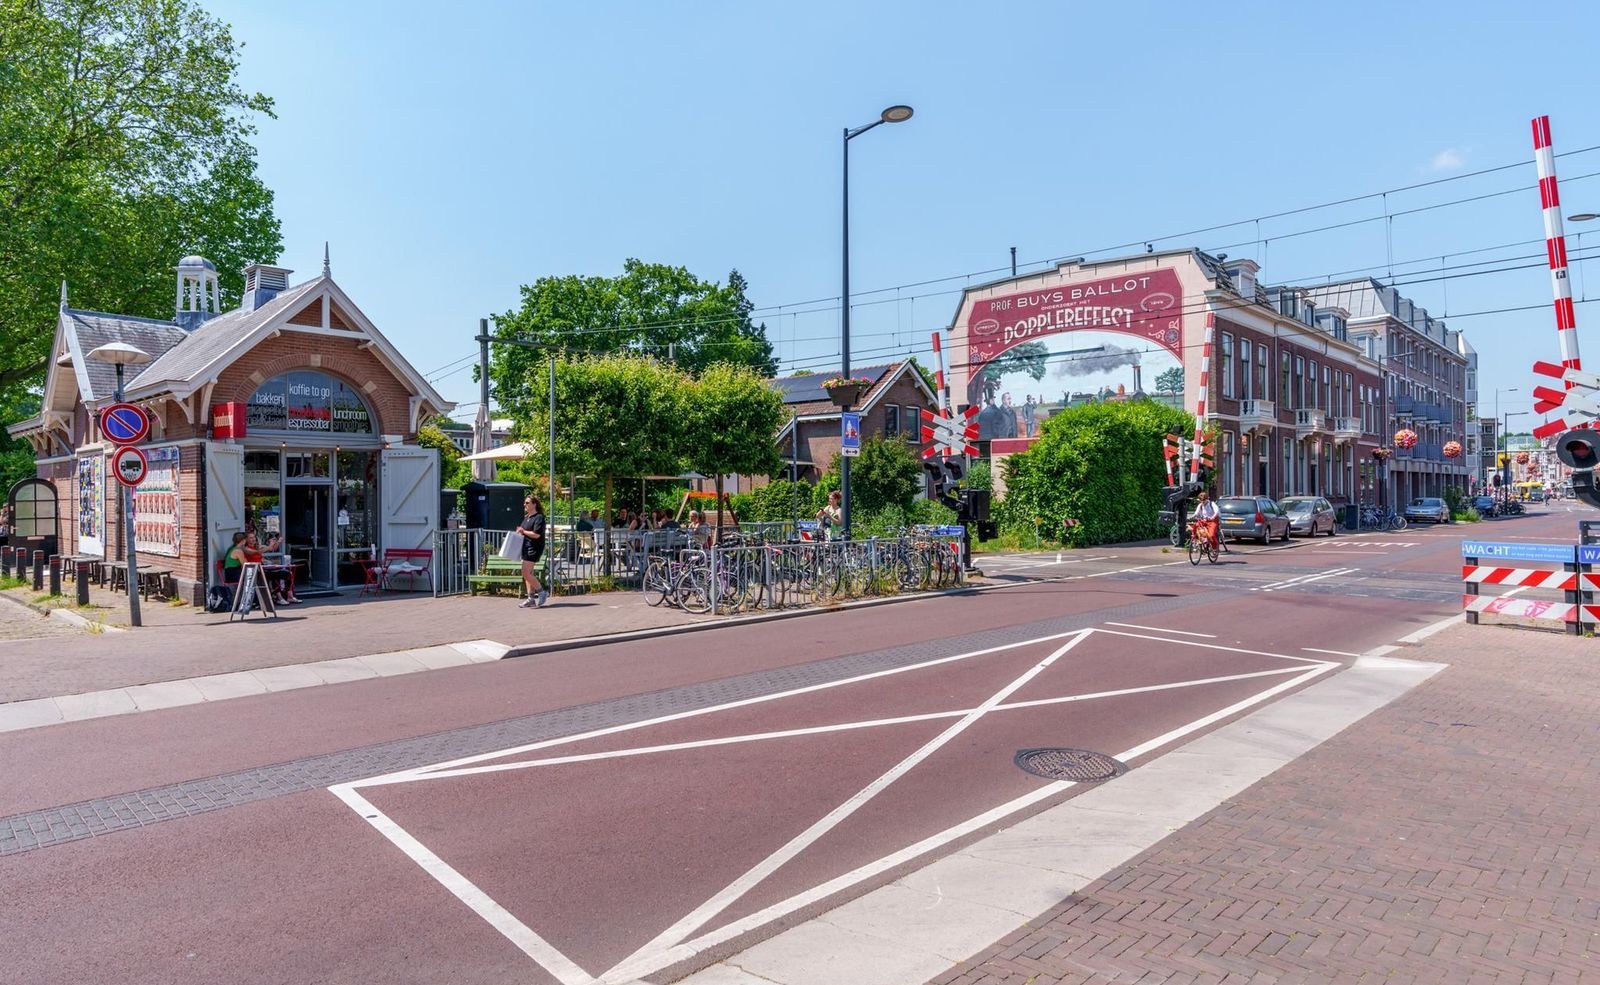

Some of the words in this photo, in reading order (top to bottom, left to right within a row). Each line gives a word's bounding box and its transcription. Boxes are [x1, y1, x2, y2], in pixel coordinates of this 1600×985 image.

[991, 300, 1013, 312] PROF.
[1017, 291, 1063, 308] BUYS
[1071, 277, 1150, 299] BALLOT
[1004, 306, 1134, 345] DOPPLEREFFECT
[256, 392, 286, 407] bakkerij
[289, 384, 311, 396] koffie
[311, 385, 320, 397] to
[321, 387, 331, 400] go
[333, 407, 368, 421] lunchroom
[288, 418, 331, 430] espressobar
[1464, 544, 1511, 557] WACHT
